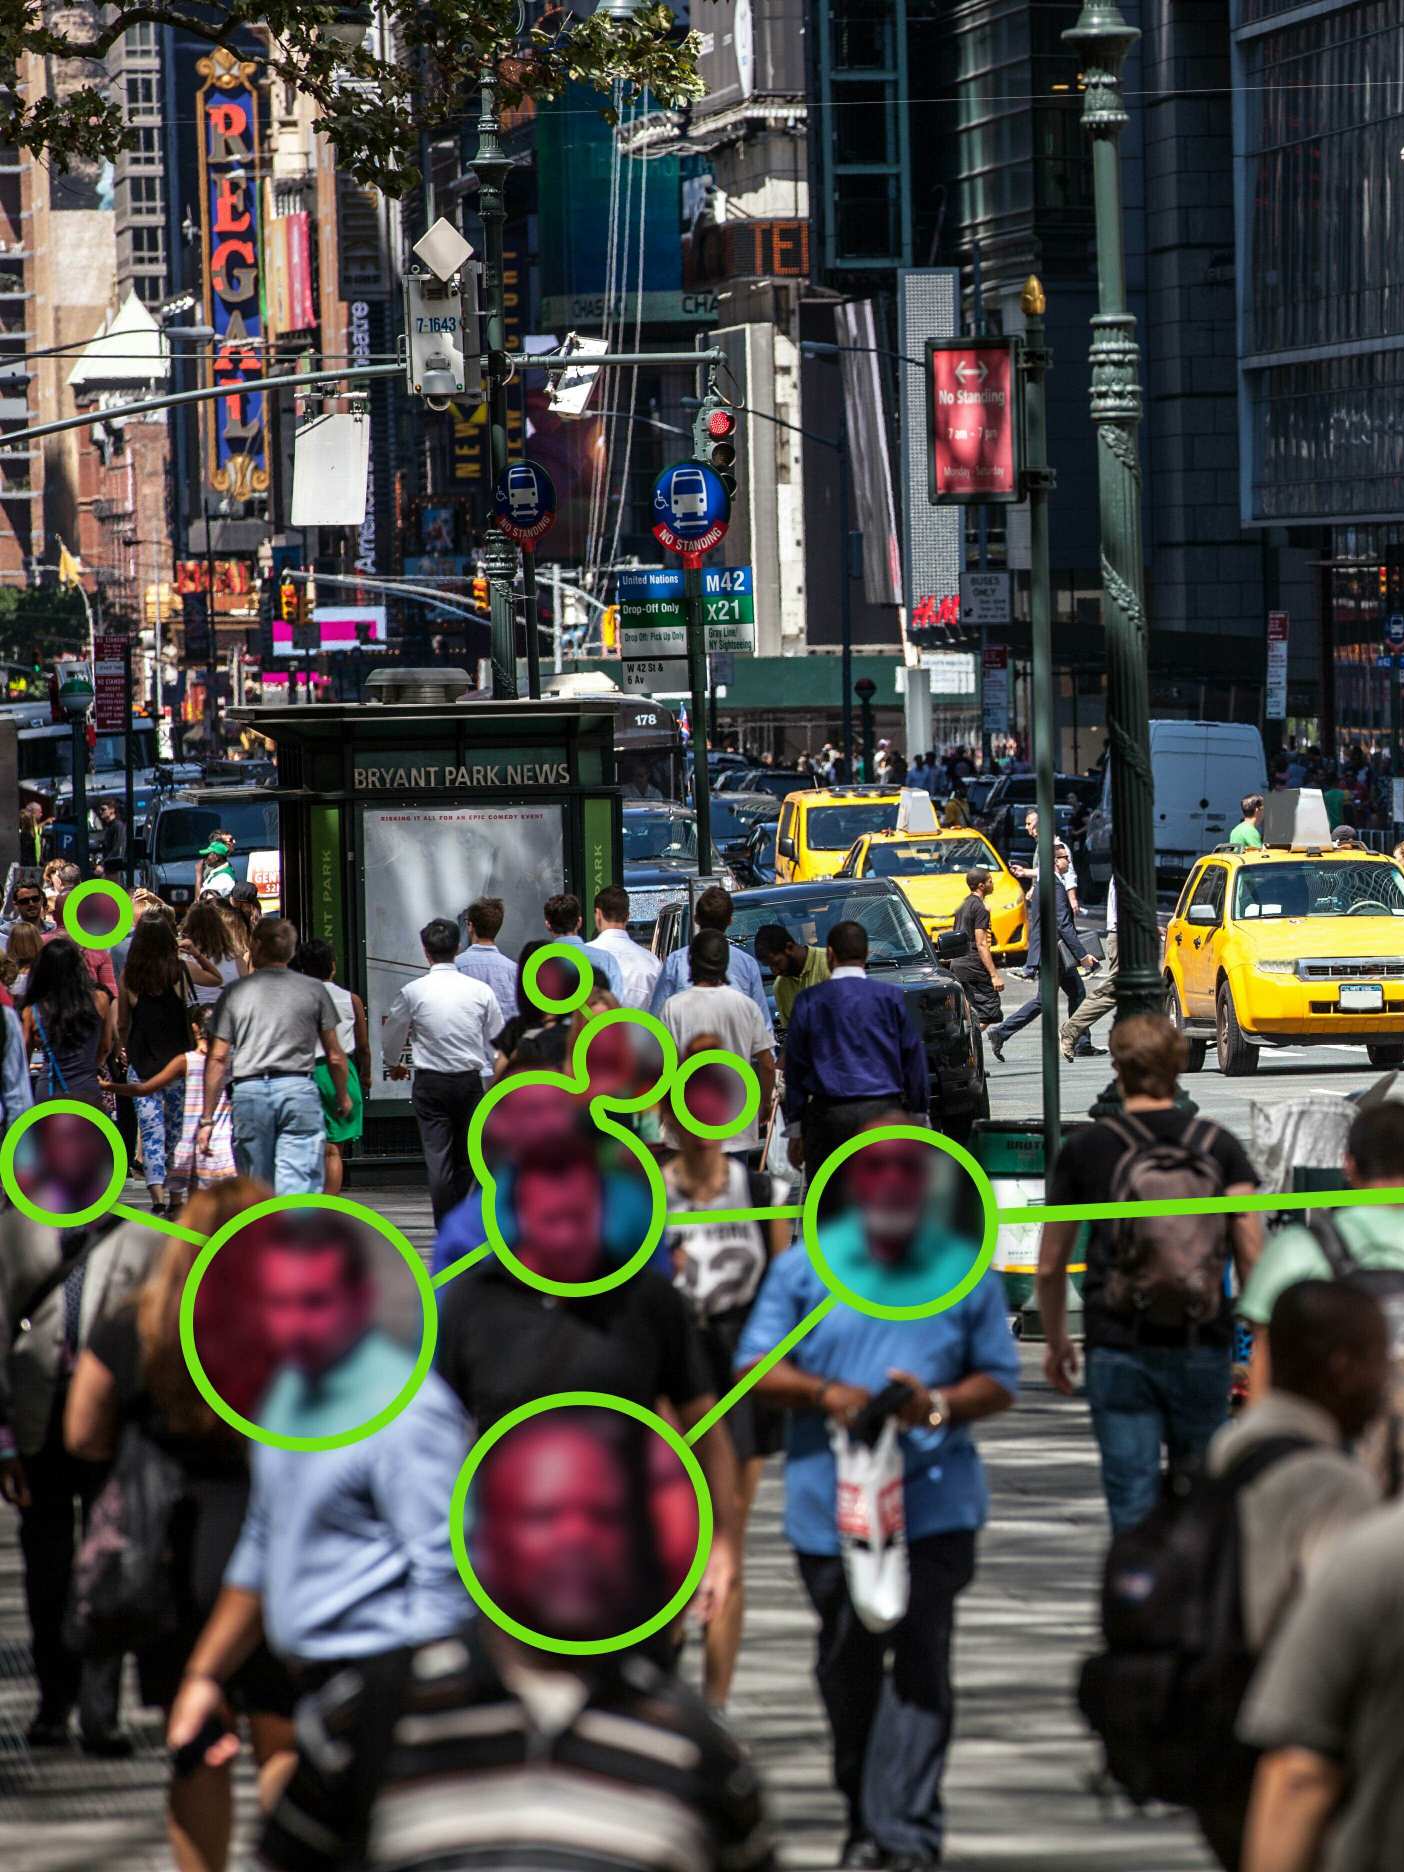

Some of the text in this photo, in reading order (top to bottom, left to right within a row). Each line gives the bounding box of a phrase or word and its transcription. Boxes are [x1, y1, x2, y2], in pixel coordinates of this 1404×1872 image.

[207, 103, 262, 439] REGAL
[683, 296, 720, 314] CHA
[416, 317, 457, 333] 7-1643
[938, 388, 1005, 406] No Standing
[501, 517, 550, 539] NO STANDING
[659, 527, 723, 552] NO STANDING
[622, 574, 679, 585] United Nations
[706, 570, 745, 592] M42
[622, 602, 680, 616] Drop-Off Only
[708, 640, 718, 651] NY
[627, 663, 664, 673] W 42 St &
[634, 675, 645, 685] Av
[634, 714, 657, 725] 178
[353, 763, 570, 789] BRYANT PARK NEWS
[63, 834, 73, 849] P
[254, 872, 280, 883] GEN
[321, 850, 333, 902] PARK
[1006, 1139, 1043, 1150] BRUT
